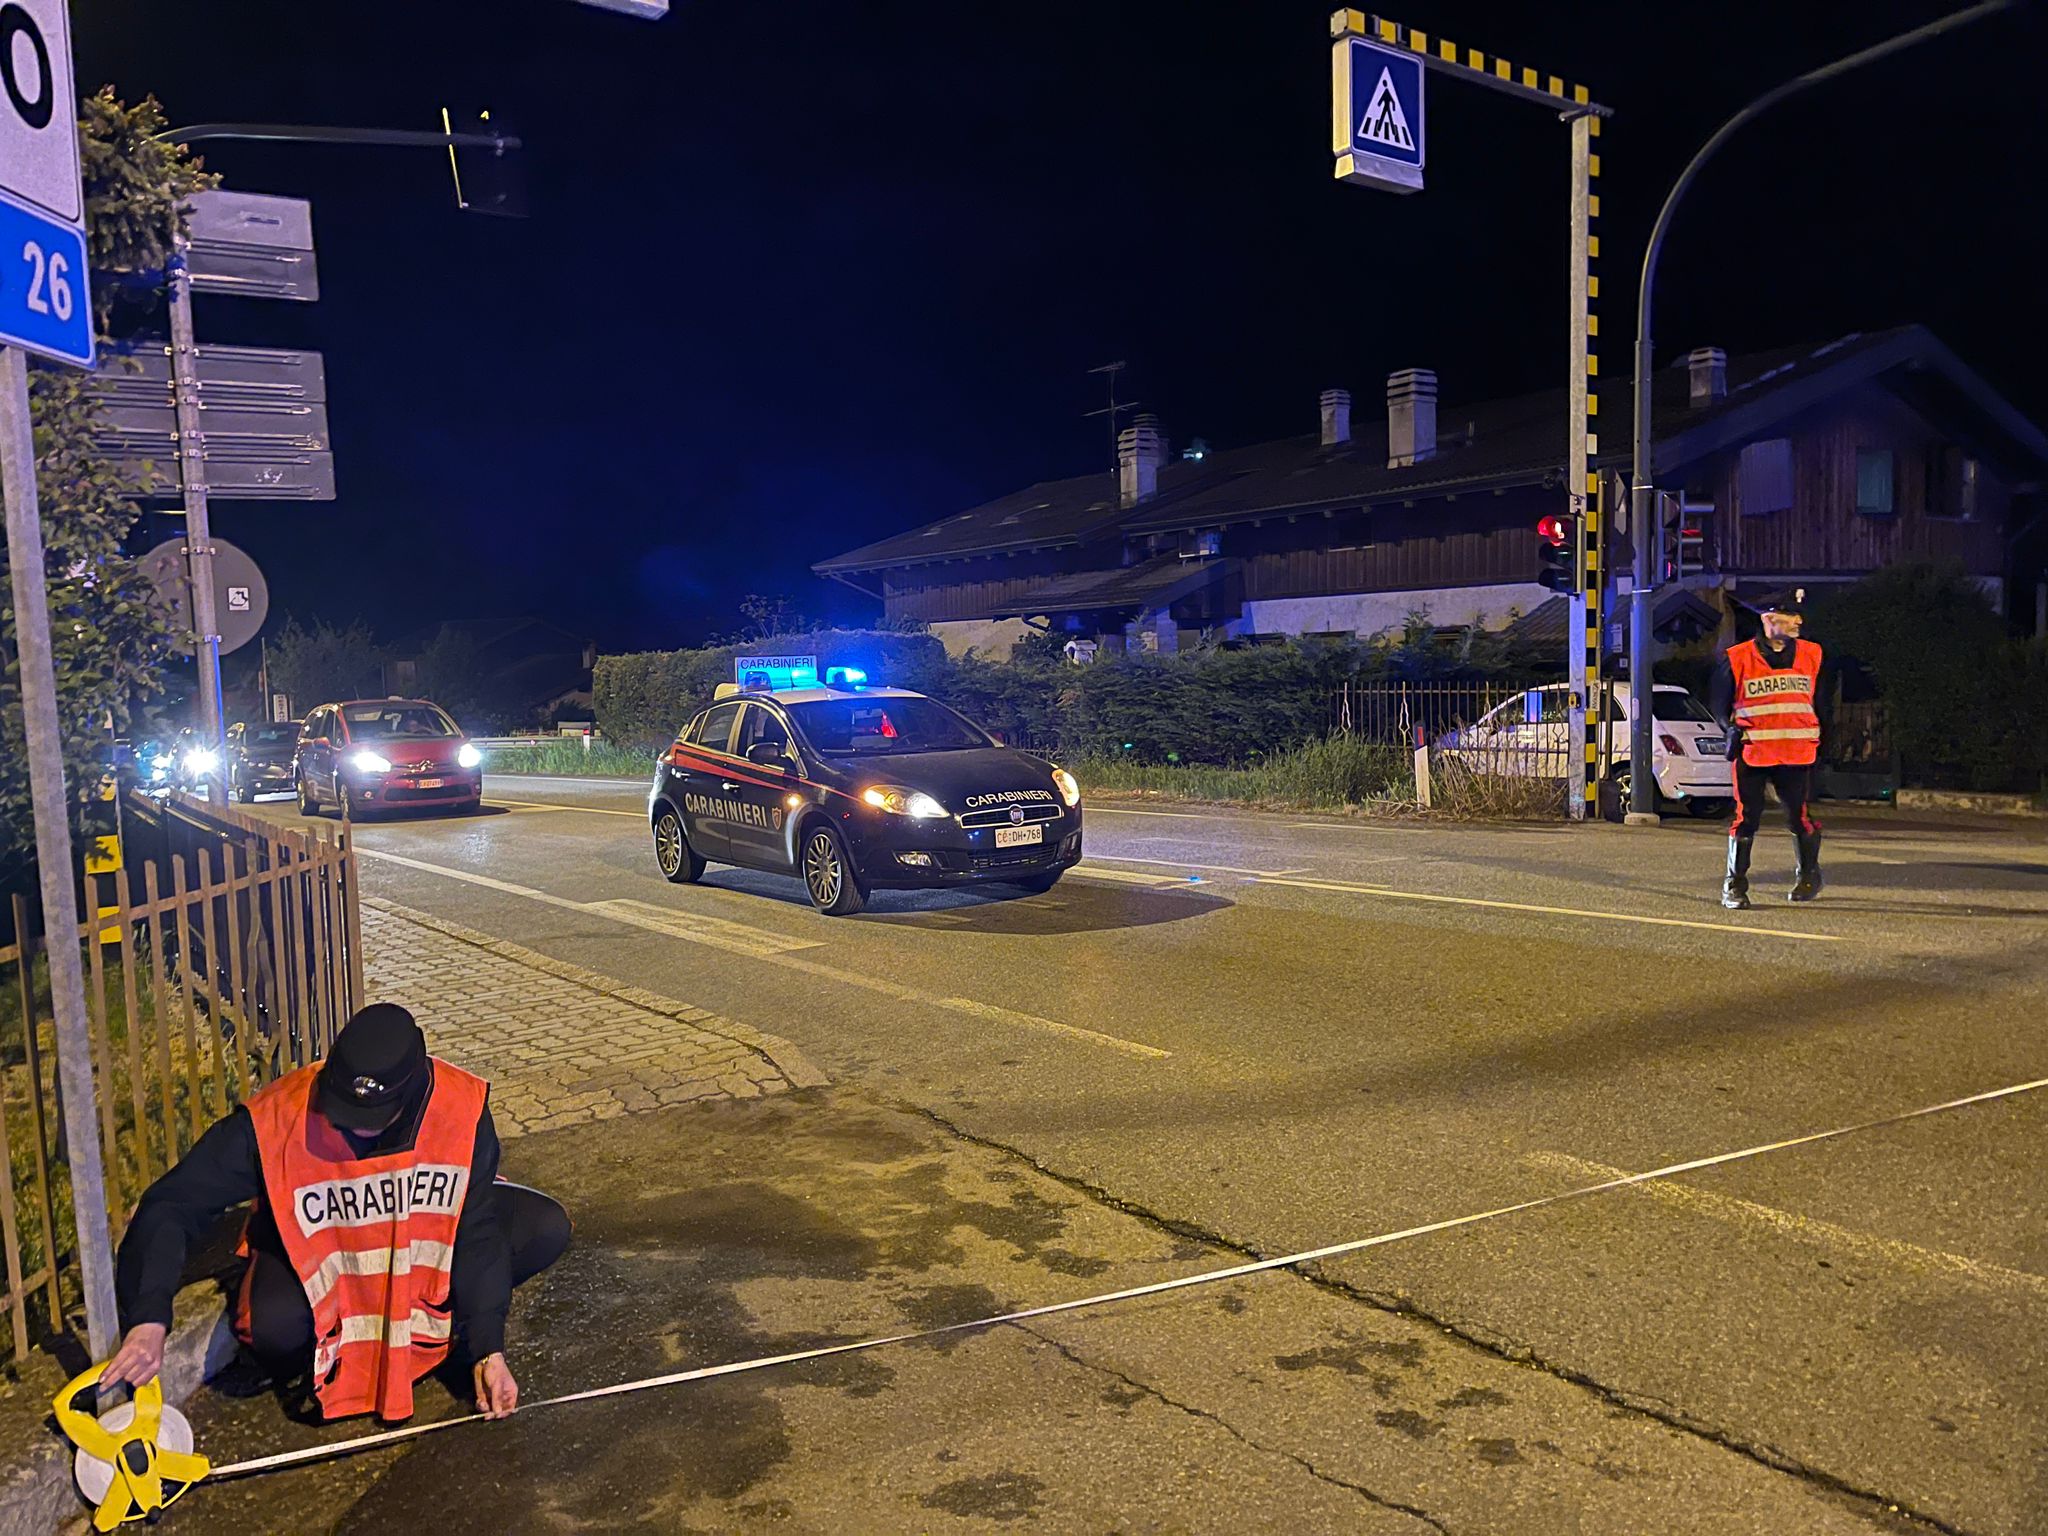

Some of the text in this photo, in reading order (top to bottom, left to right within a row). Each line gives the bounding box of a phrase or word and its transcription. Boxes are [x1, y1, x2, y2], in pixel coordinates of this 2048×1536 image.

[23, 240, 72, 321] 26
[740, 658, 813, 669] CARABINIERI
[685, 792, 768, 827] CARABINIERI
[966, 790, 1053, 808] CARABINIERI
